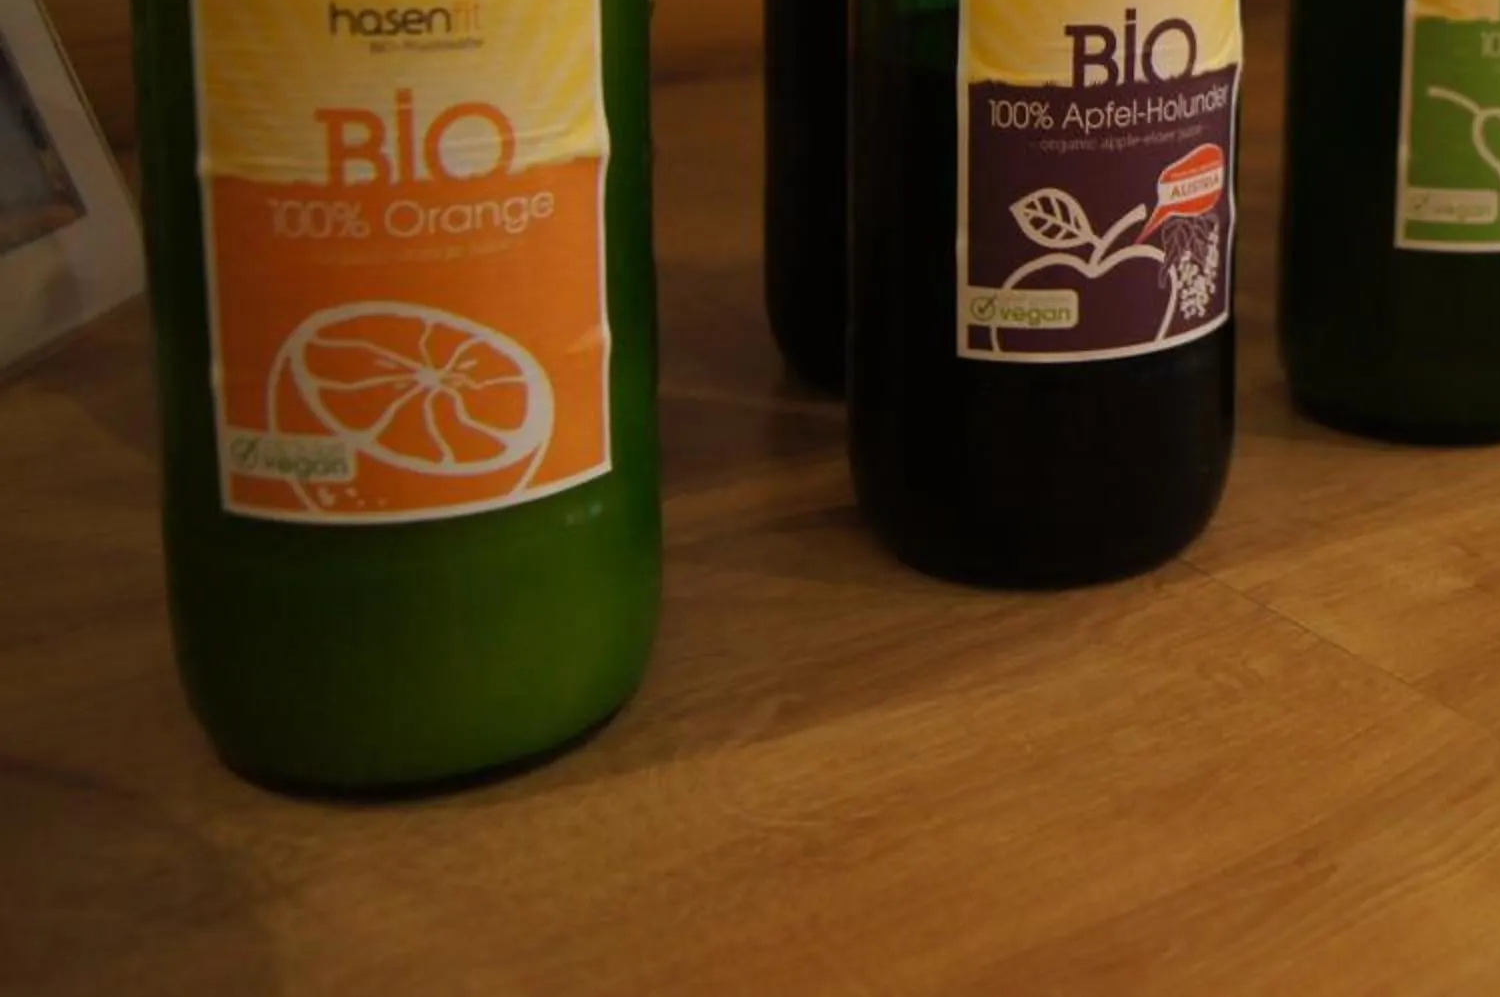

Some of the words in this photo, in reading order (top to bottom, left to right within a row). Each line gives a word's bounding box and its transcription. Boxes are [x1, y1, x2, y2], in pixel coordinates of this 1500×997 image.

[989, 99, 1055, 131] 100%
[1062, 83, 1229, 135] Apfel-Holunder
[384, 191, 555, 238] Orange
[1000, 302, 1073, 326] vegan
